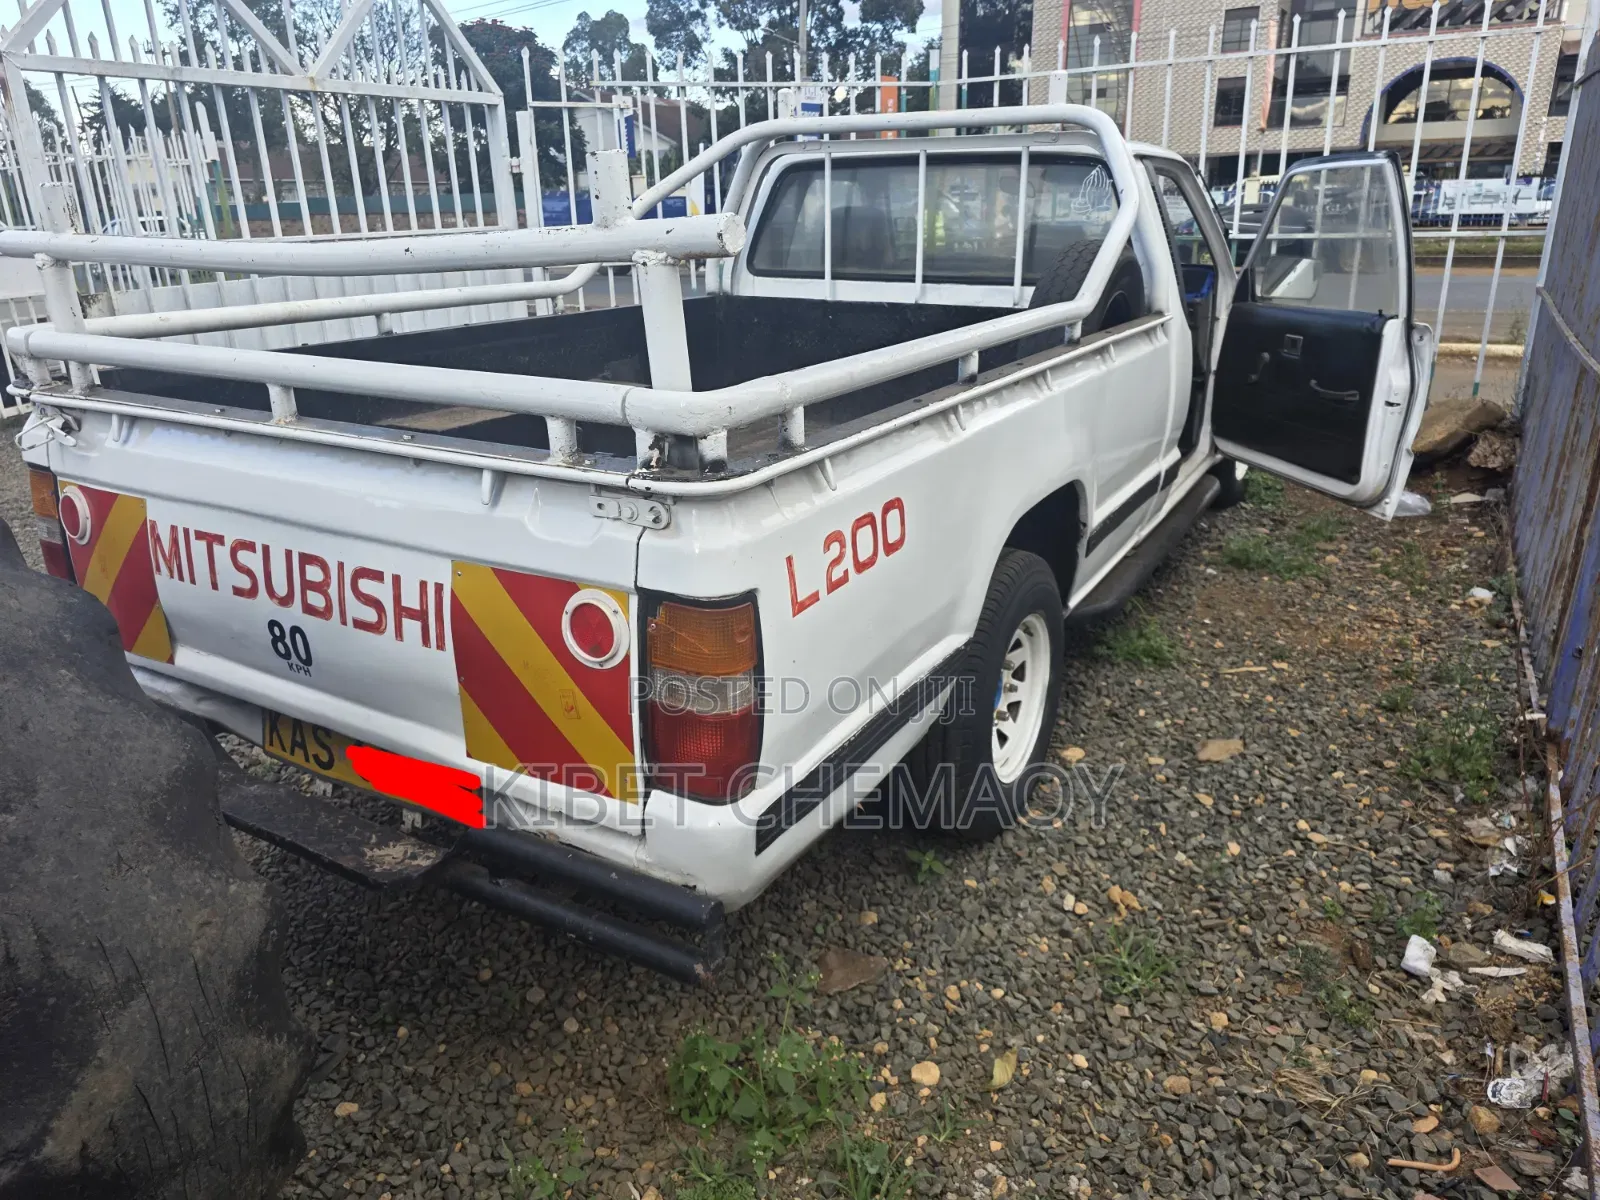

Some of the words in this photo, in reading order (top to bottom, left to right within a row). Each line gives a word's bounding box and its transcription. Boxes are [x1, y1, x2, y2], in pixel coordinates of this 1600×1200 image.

[149, 518, 447, 652] MITSUBISHI
[785, 496, 906, 618] L200
[267, 619, 313, 667] 80
[287, 661, 312, 678] KPH
[268, 711, 335, 771] KAS
